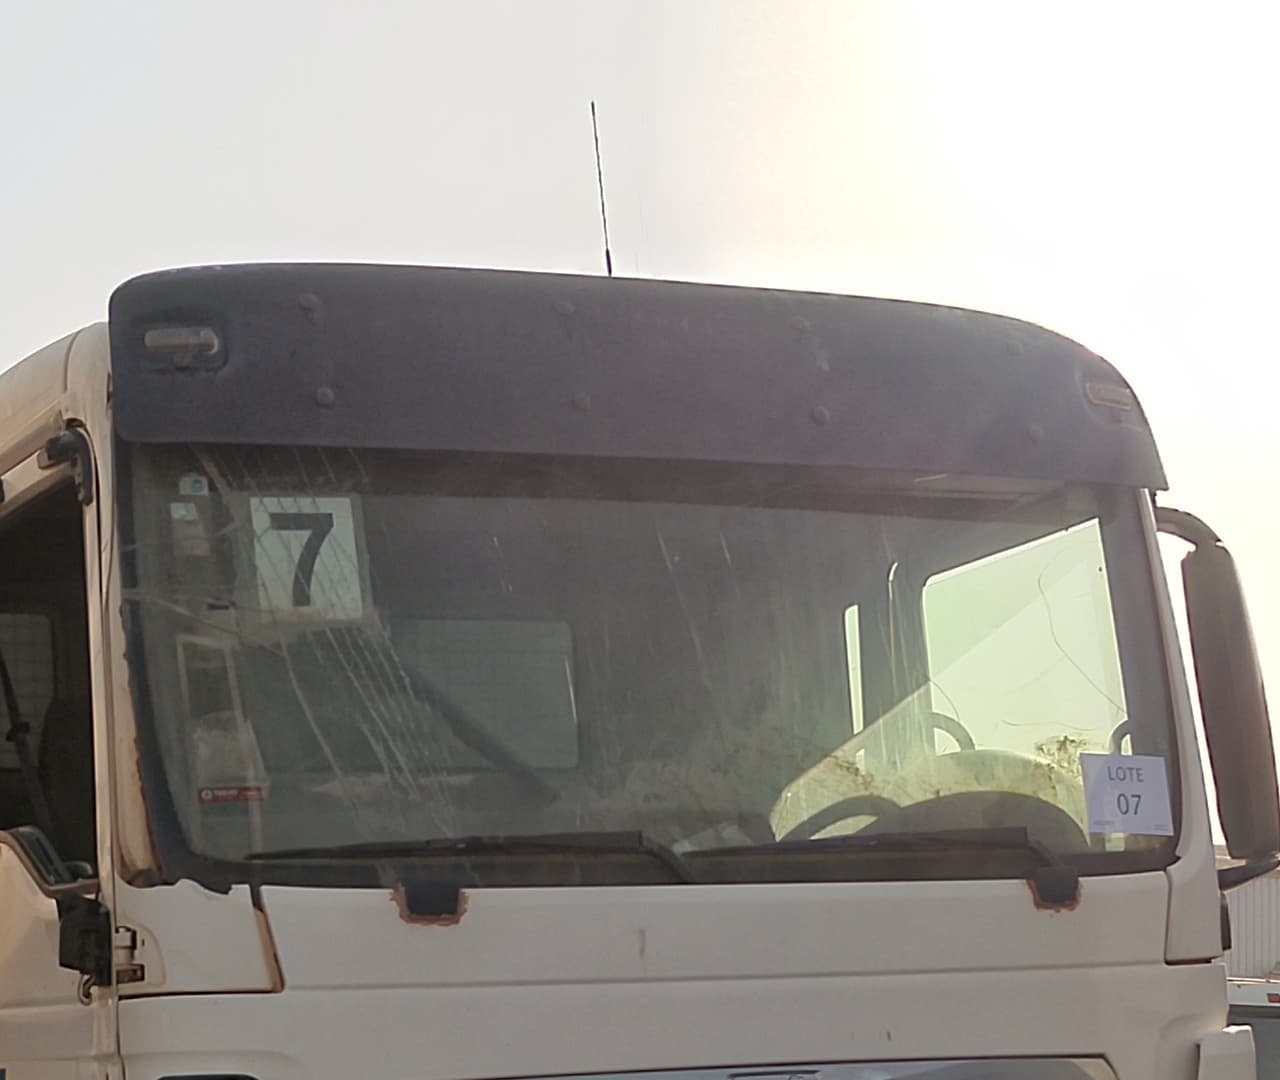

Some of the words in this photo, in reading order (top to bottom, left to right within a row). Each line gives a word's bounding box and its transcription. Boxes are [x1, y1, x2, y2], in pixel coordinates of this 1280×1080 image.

[269, 512, 335, 607] 7
[1107, 766, 1145, 783] LOTE
[1116, 792, 1142, 815] 07
